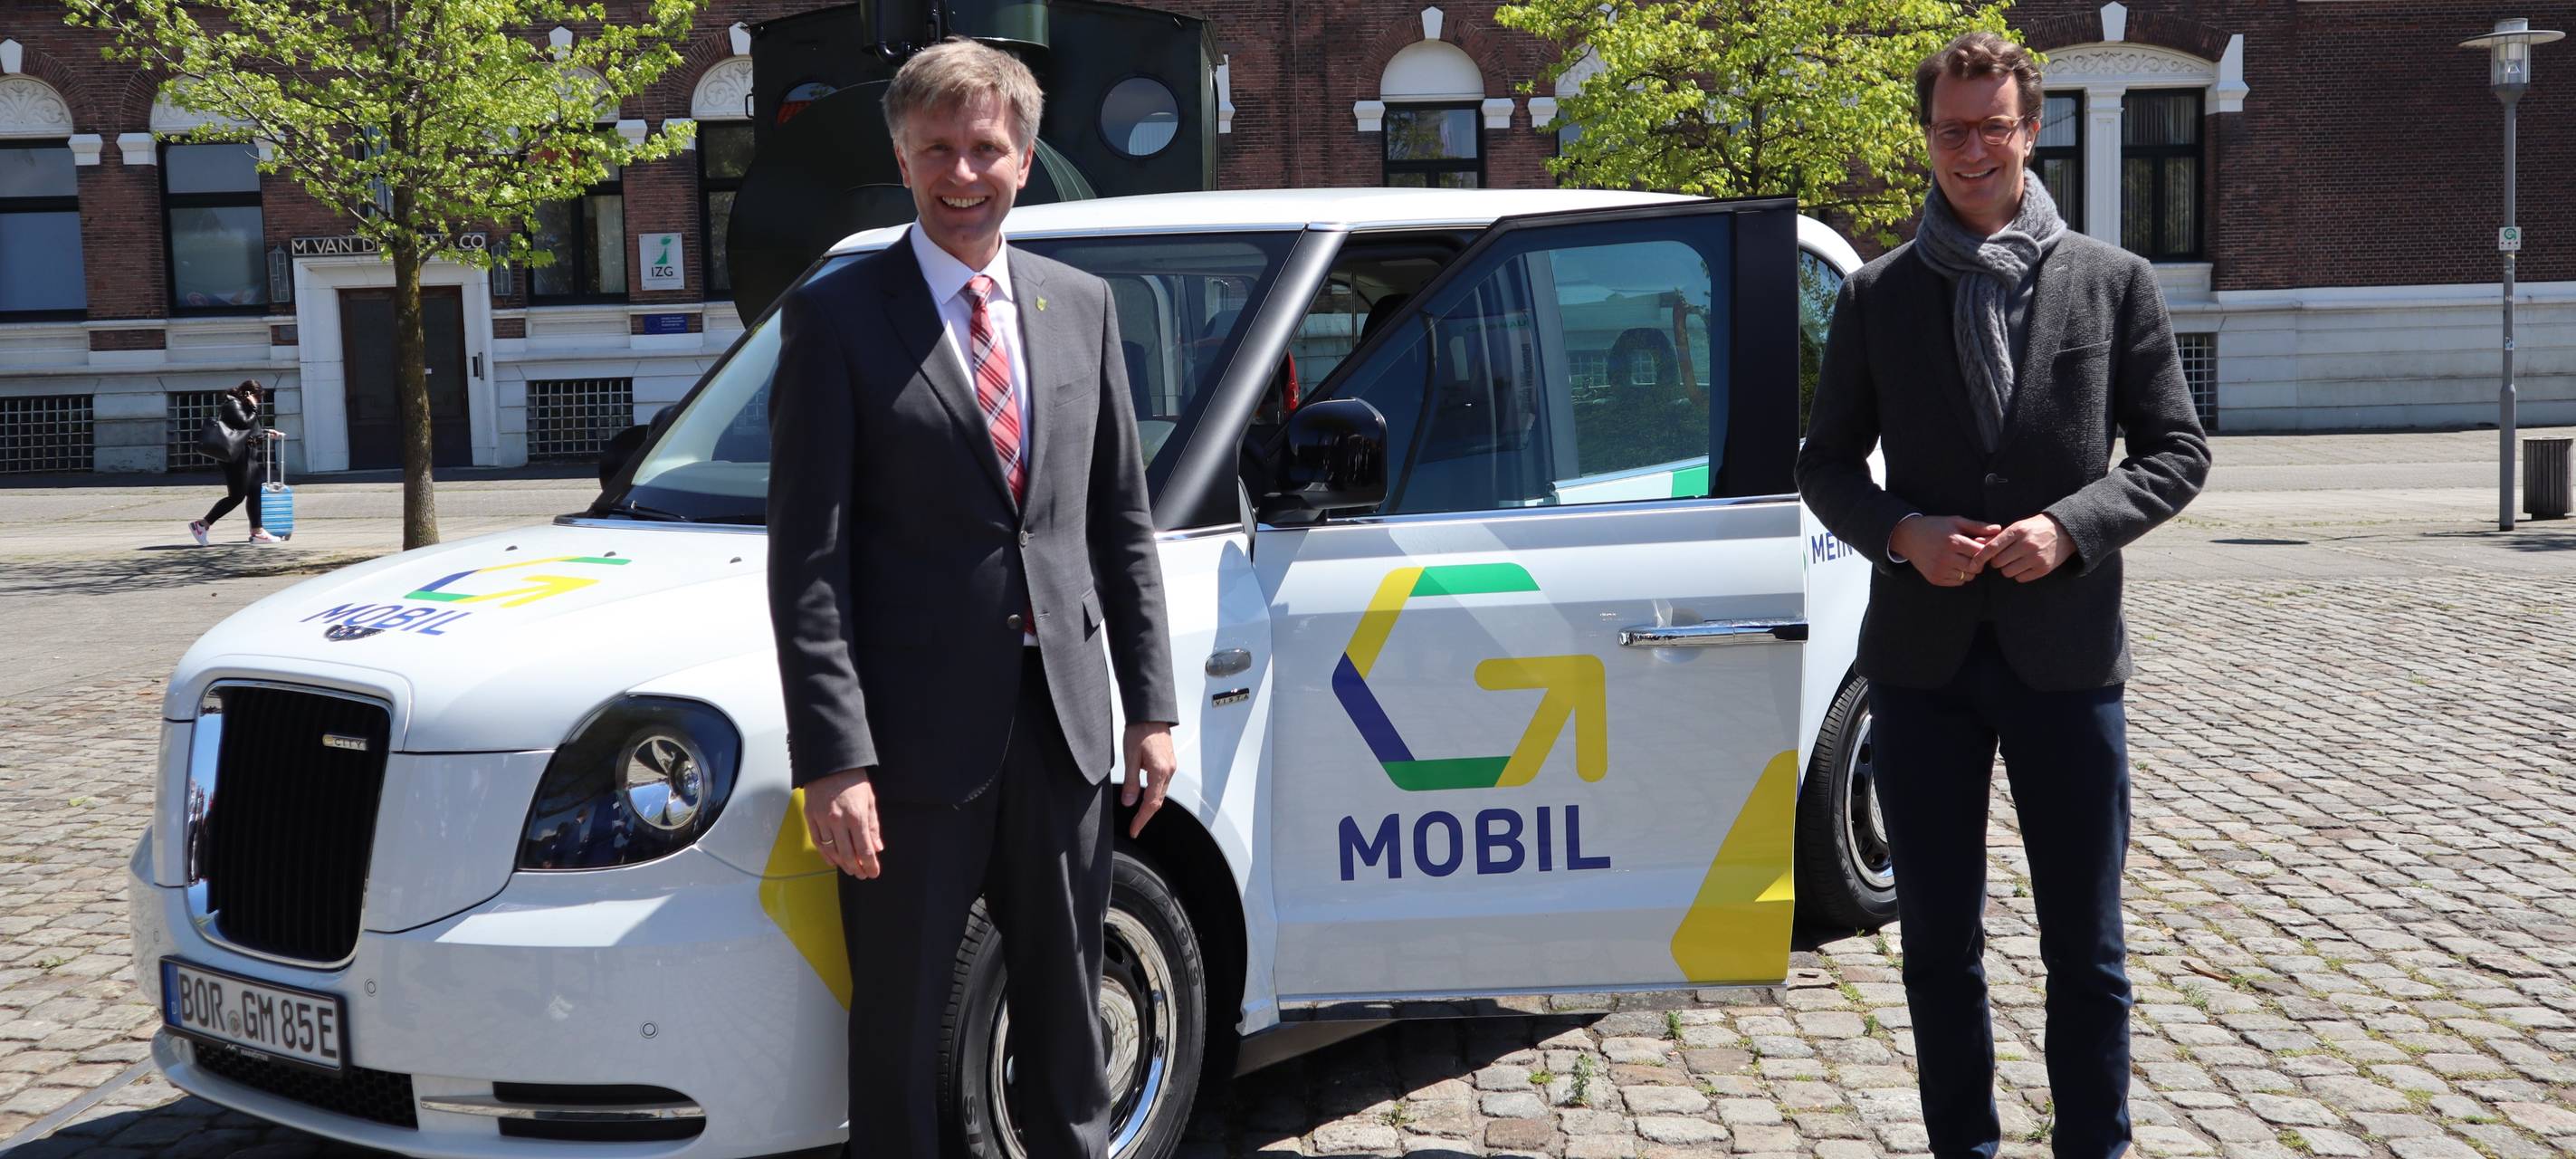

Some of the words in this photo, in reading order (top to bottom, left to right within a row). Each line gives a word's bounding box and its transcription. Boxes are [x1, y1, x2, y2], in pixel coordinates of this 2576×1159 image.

[651, 266, 673, 277] IZG
[299, 603, 473, 636] MOBIL
[1216, 694, 1249, 705] VISTA
[1338, 805, 1611, 881] MOBIL
[179, 973, 225, 1032] BOR
[242, 991, 276, 1045] GM
[281, 999, 338, 1058] 85E
